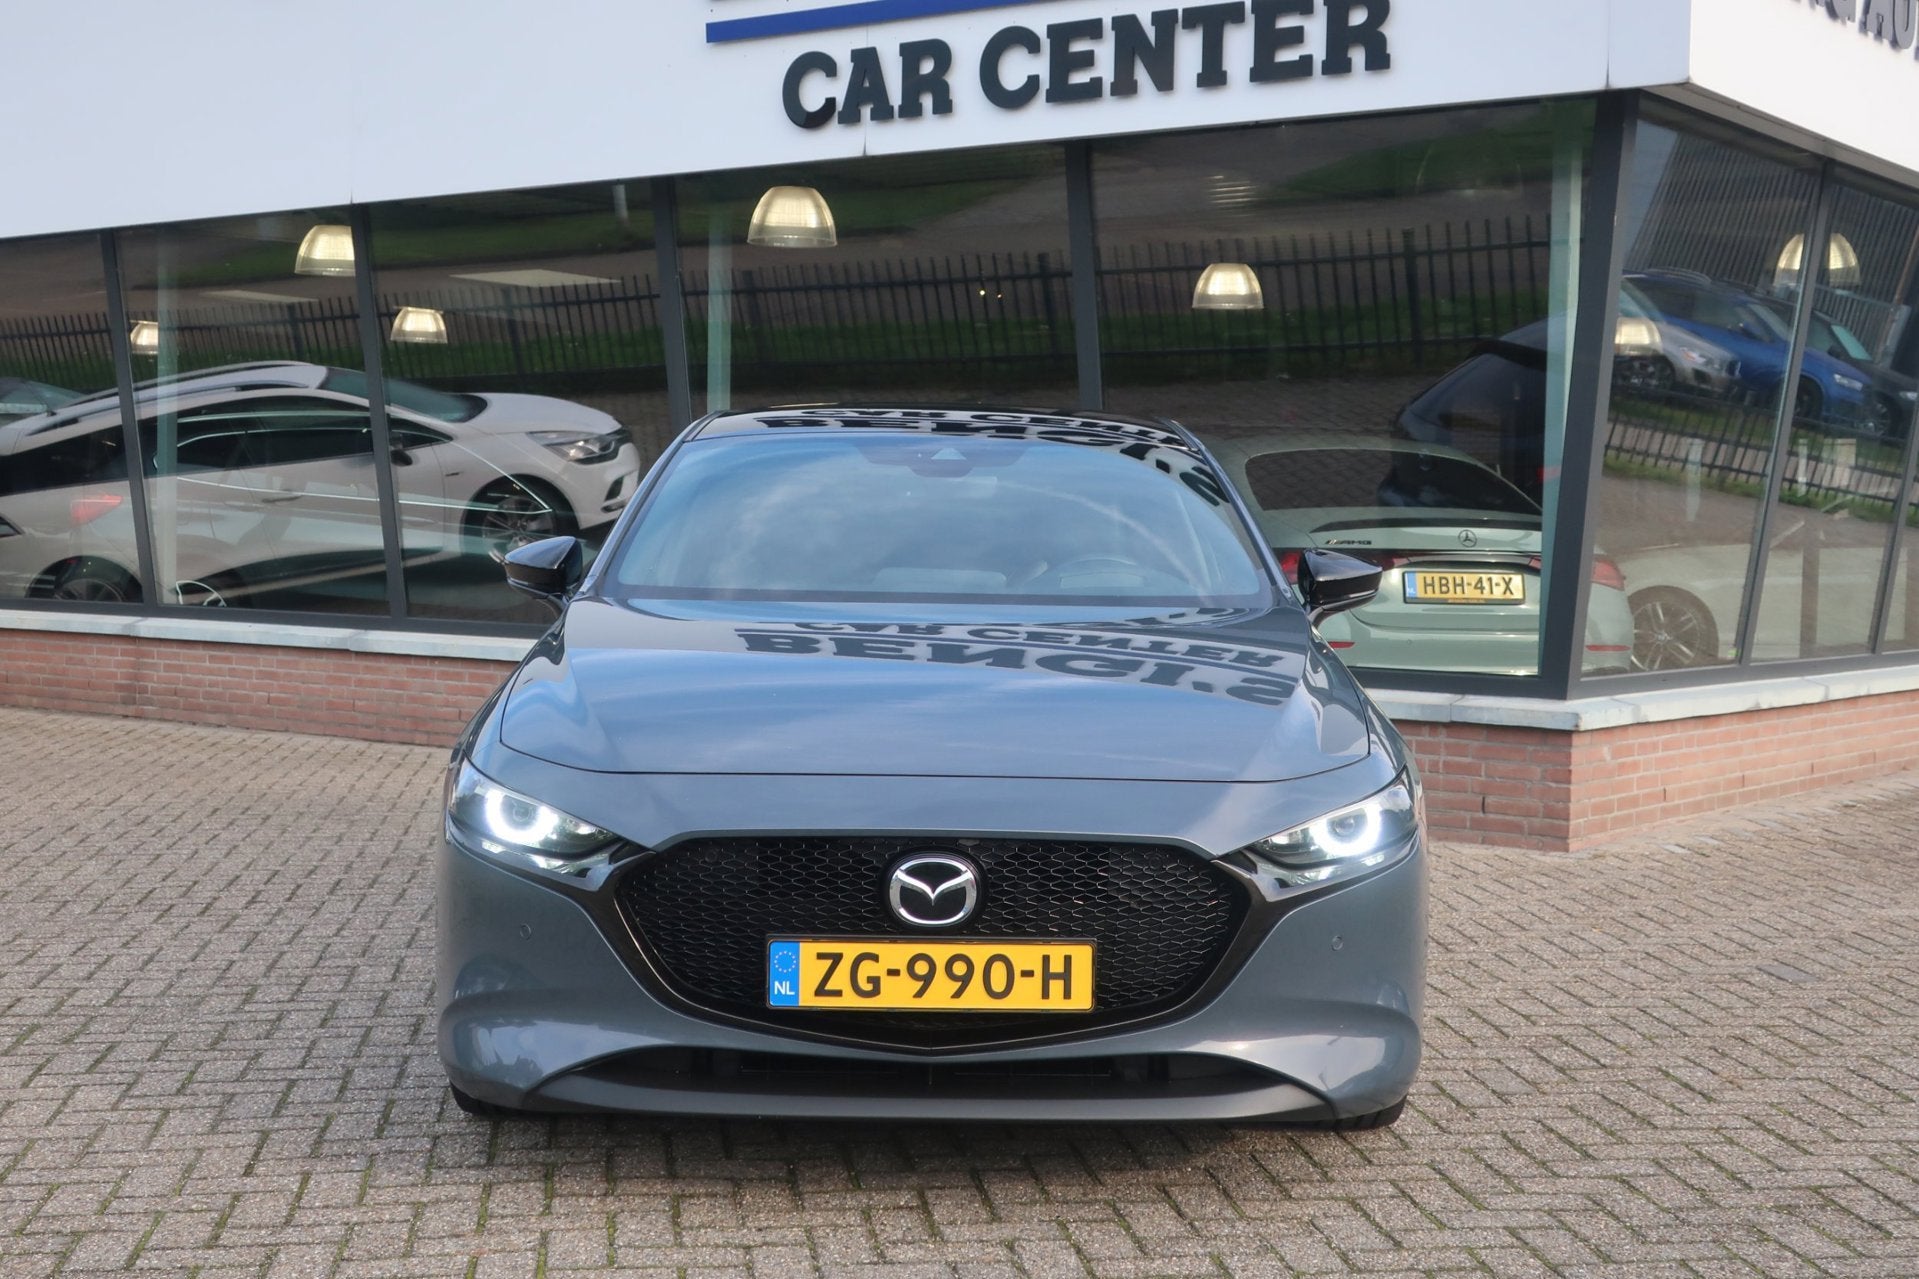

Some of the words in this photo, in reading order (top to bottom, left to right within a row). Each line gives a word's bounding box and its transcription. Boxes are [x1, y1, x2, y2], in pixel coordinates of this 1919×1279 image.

[782, 38, 953, 129] CAR
[979, 0, 1391, 109] CENTER
[1423, 575, 1515, 596] HBH-41-X
[774, 980, 796, 995] NL
[813, 951, 1073, 1001] ZG-990-H
